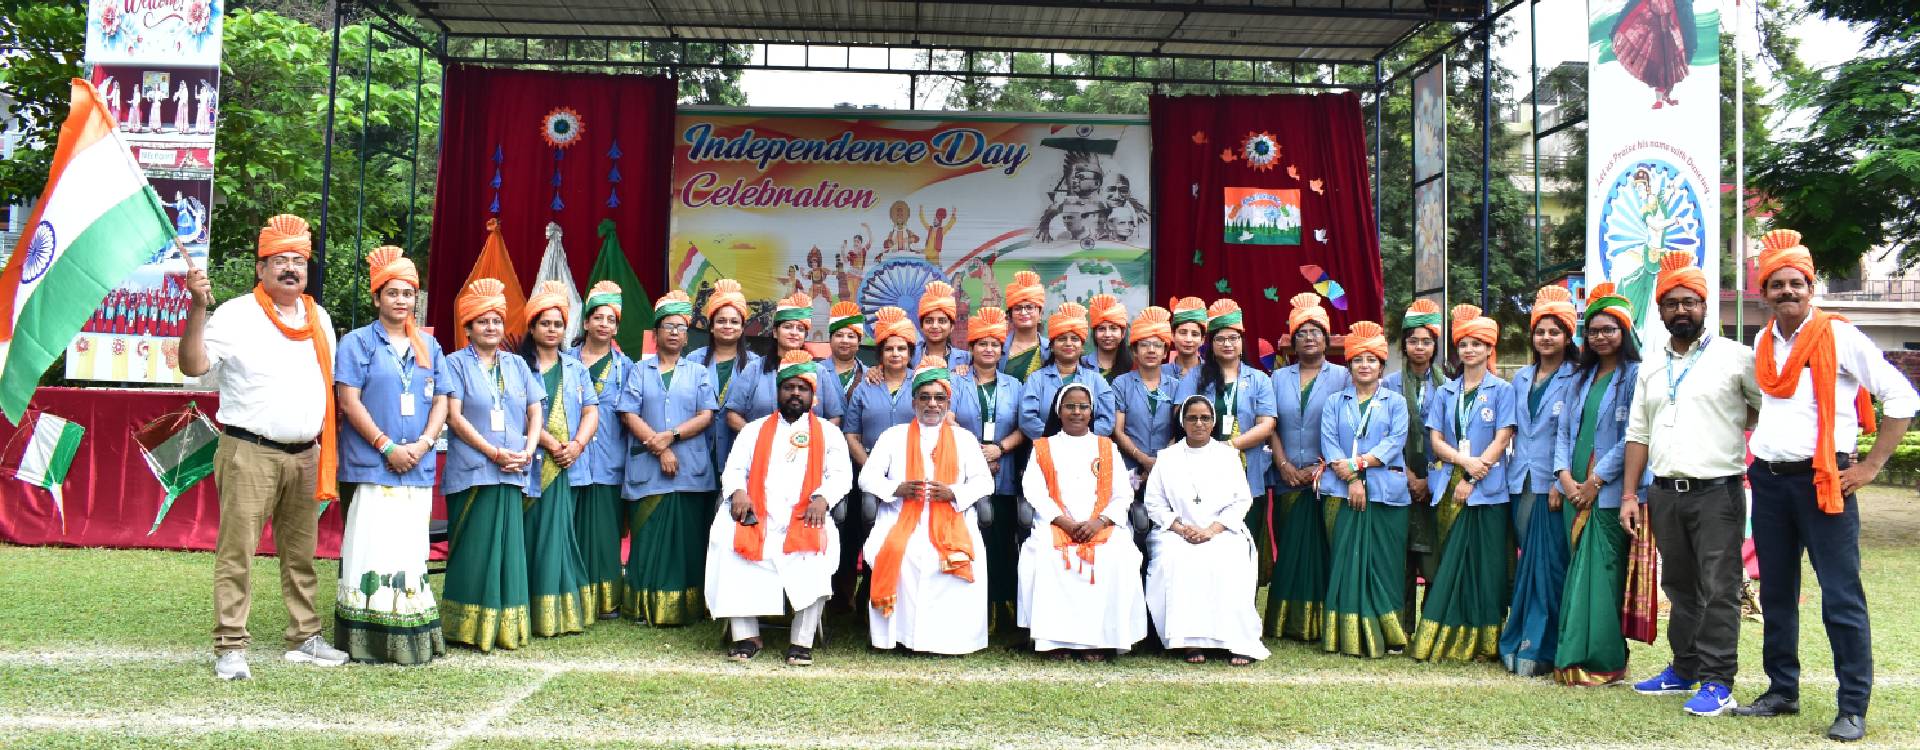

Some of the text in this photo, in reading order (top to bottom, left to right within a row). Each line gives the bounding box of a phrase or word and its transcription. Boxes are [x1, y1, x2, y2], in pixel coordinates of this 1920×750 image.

[684, 122, 1031, 175] Independence Day
[1612, 144, 1636, 163] Praise
[1637, 139, 1649, 149] his
[1650, 141, 1670, 151] name
[682, 172, 877, 208] Celebration
